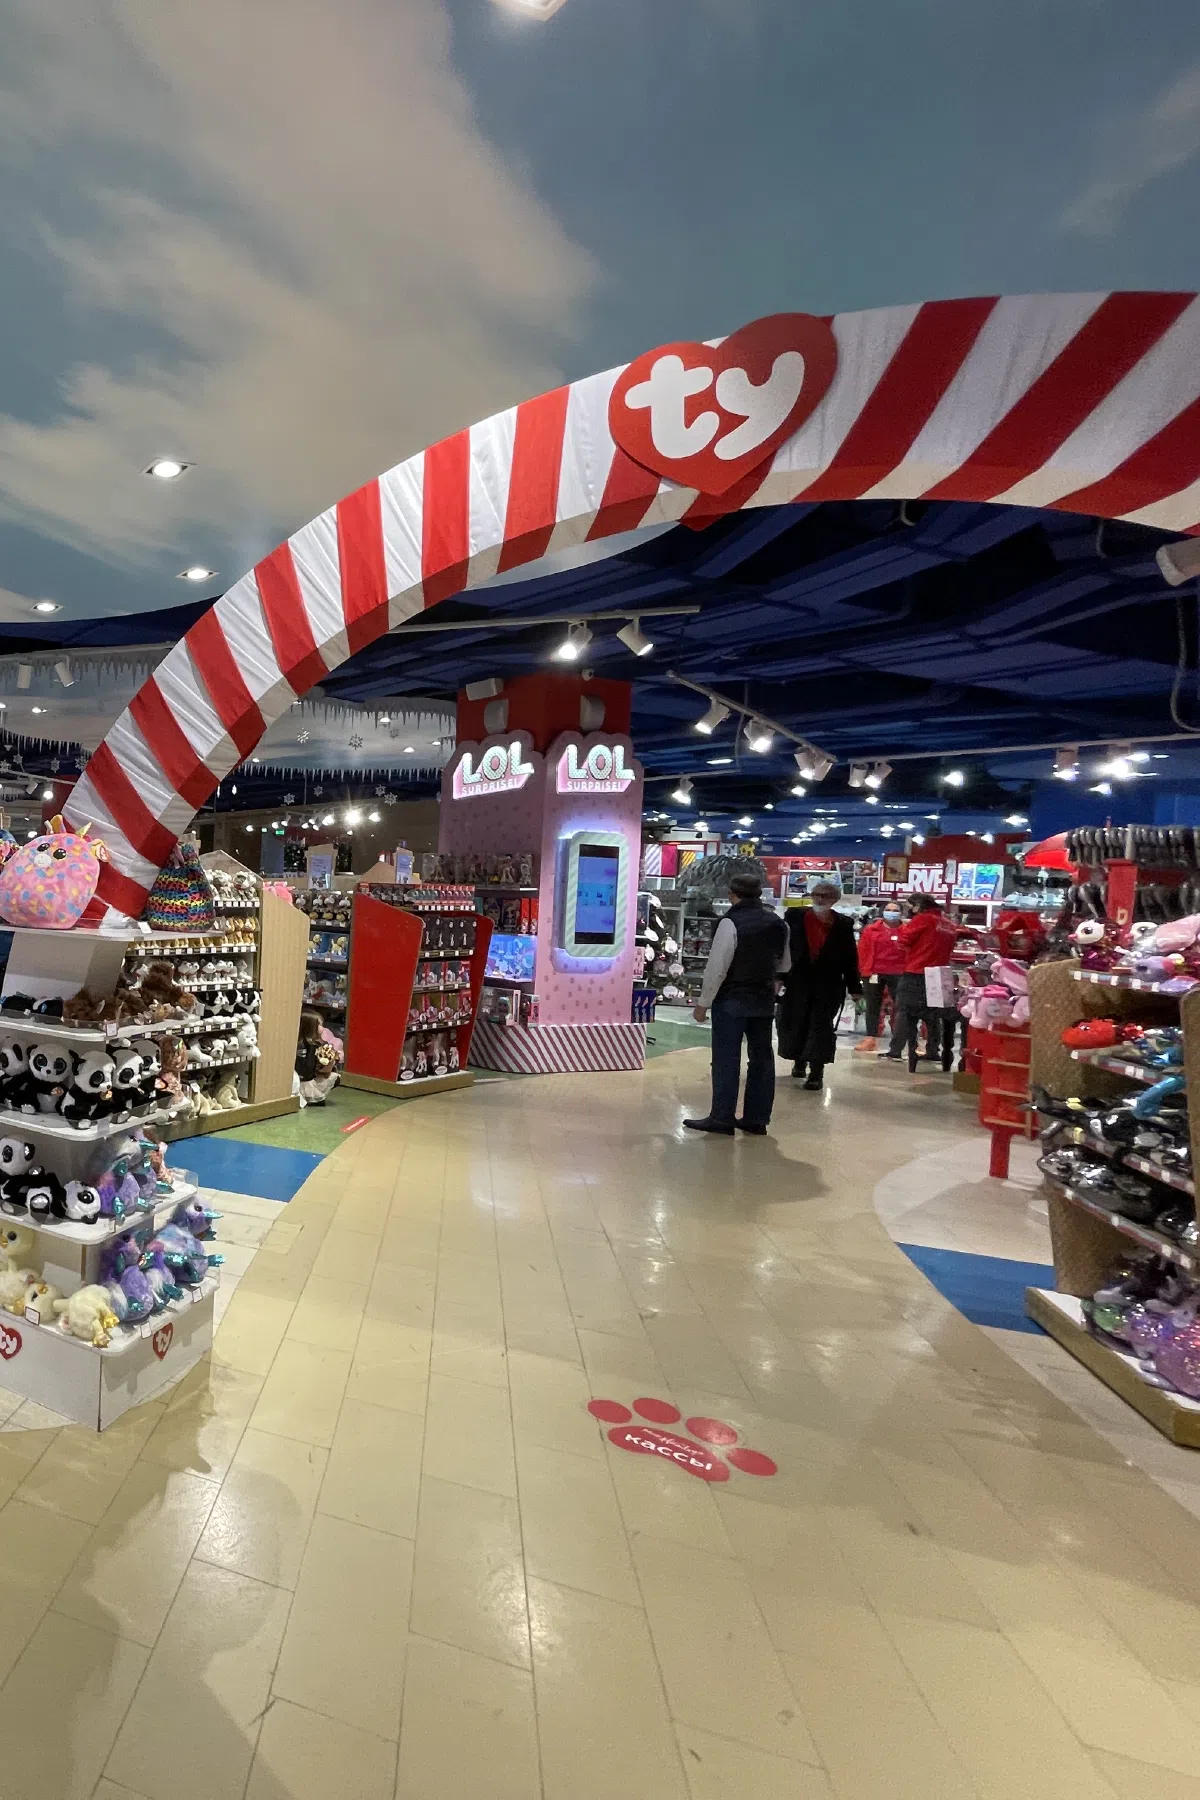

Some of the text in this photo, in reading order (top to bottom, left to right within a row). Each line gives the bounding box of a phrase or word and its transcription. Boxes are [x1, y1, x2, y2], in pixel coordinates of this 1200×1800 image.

[624, 350, 806, 461] ty
[461, 778, 519, 796] SURPRISE!
[566, 780, 621, 792] SURPRISE!
